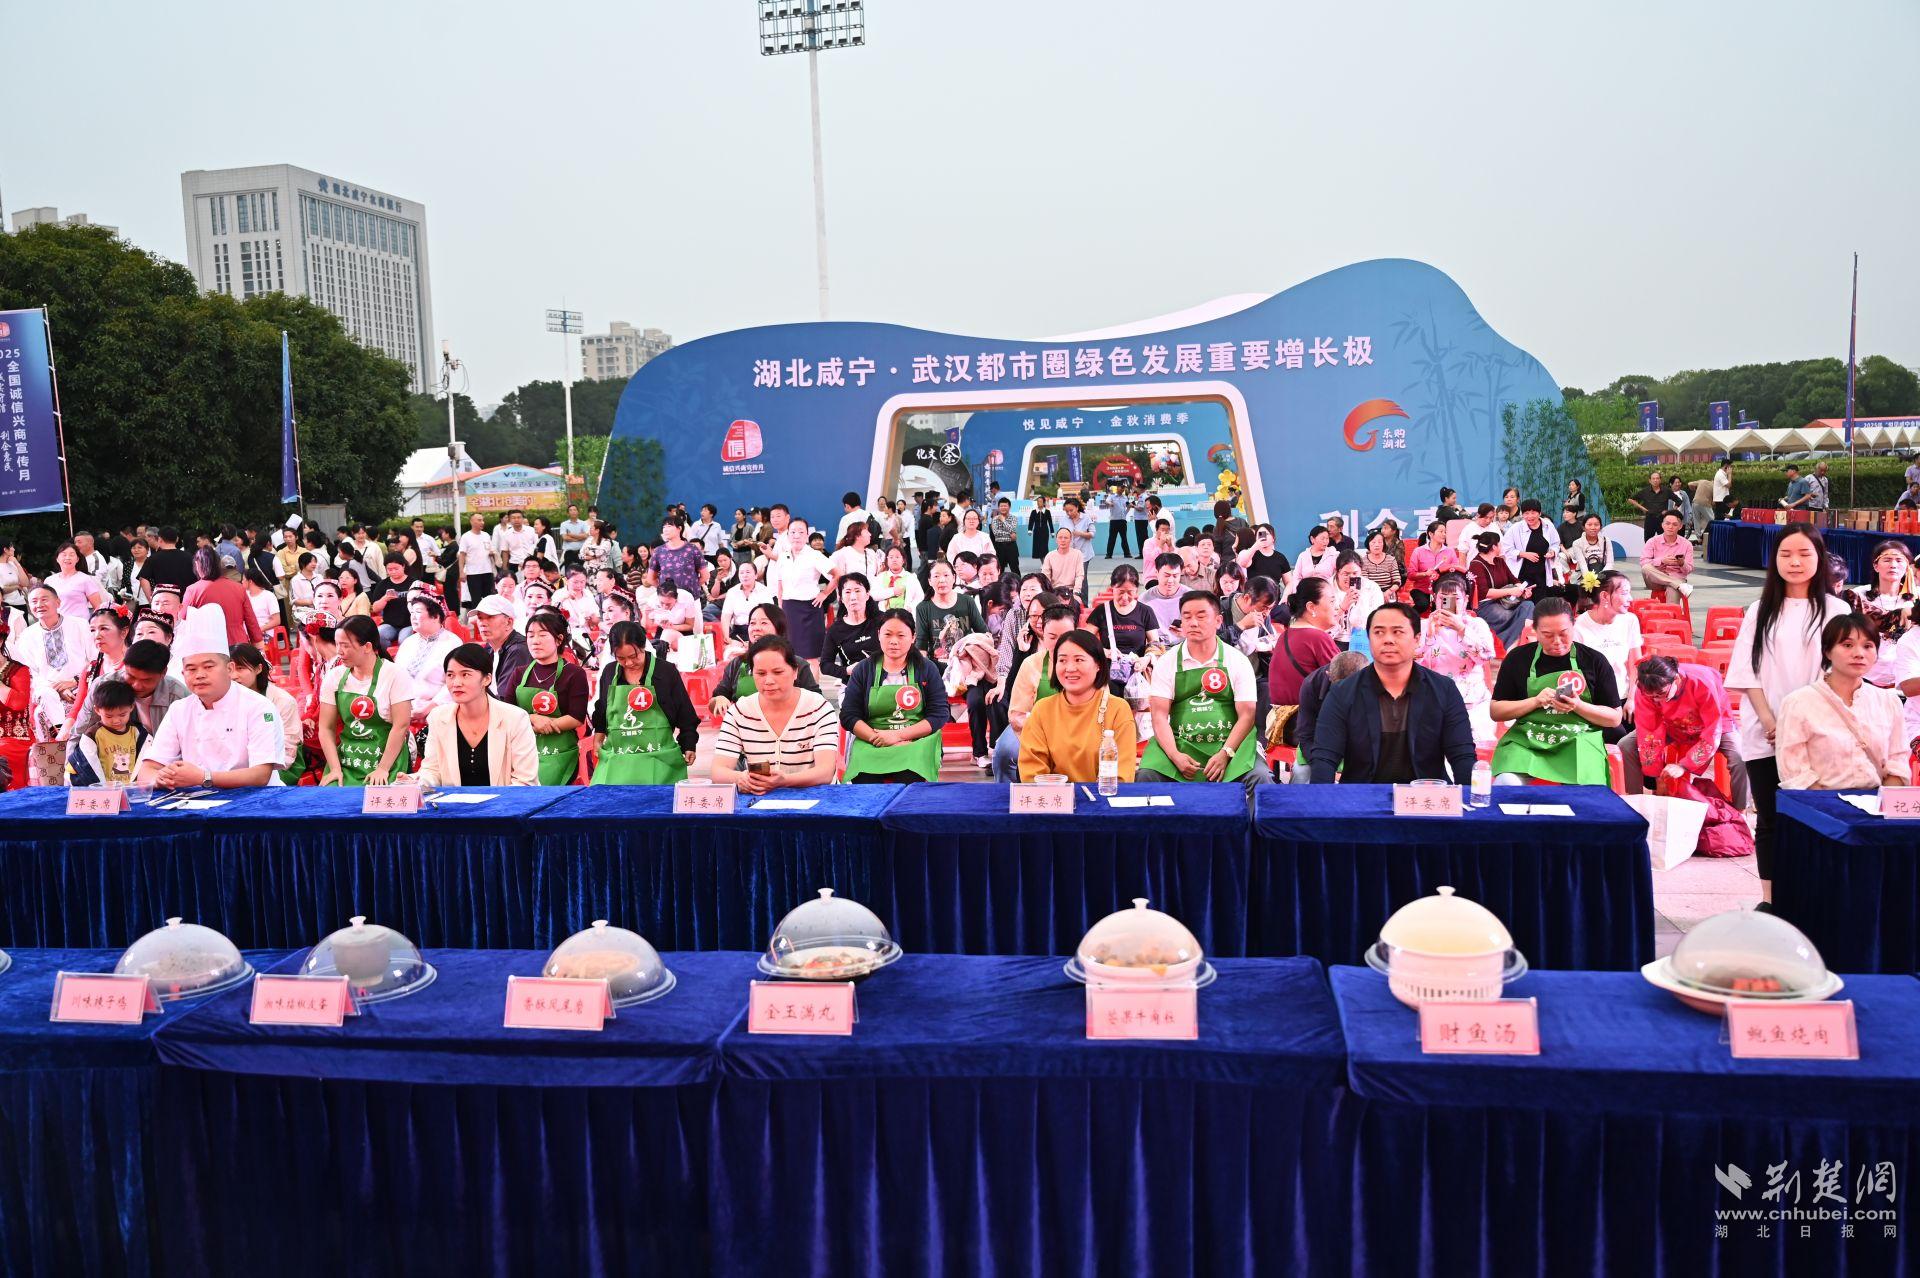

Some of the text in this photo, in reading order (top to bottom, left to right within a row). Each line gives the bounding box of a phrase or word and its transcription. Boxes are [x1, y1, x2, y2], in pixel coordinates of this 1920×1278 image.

[753, 335, 1374, 389] 湖北咸宁·武汉都市圈绿色发展重要增长极
[7, 360, 31, 482] 全国诚信兴商宣传月
[1023, 412, 1189, 431] 悦见咸宁·金秋消费季
[1383, 428, 1405, 438] 乐购
[1383, 439, 1406, 449] 湖北
[1208, 672, 1222, 690] 8
[538, 695, 550, 712] 3
[633, 691, 647, 708] 4
[902, 690, 915, 707] 6
[357, 700, 370, 717] 2
[74, 798, 112, 811] 评委席
[370, 795, 409, 808] 评委席
[683, 795, 724, 809] 评委席
[1019, 794, 1063, 808] 评委席
[1404, 796, 1451, 811] 评委席
[1440, 1021, 1516, 1044] 财鱼汤
